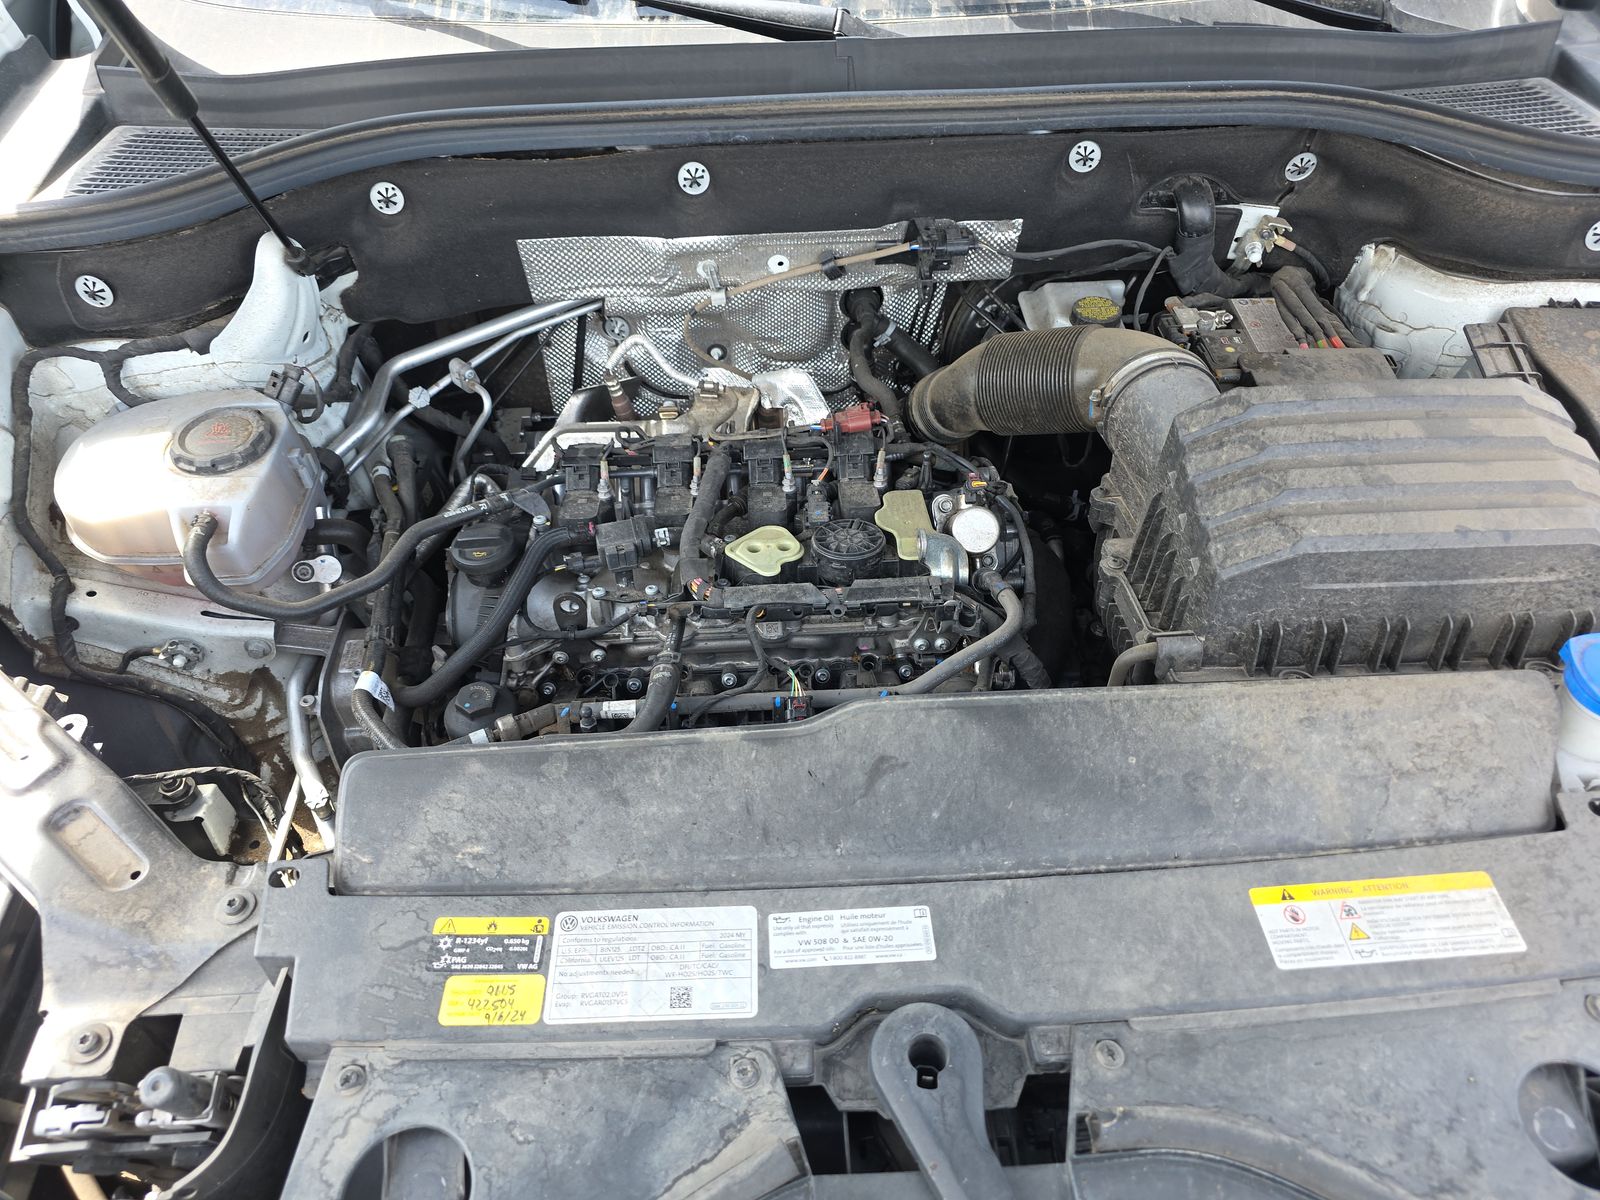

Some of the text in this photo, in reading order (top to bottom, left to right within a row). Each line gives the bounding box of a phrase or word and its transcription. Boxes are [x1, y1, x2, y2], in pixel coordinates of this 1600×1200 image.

[1310, 881, 1410, 897] WARNING ATTENTION
[581, 915, 639, 924] VOLKSWAGEN
[608, 922, 639, 930] EMISSION
[670, 920, 714, 928] INFORMATION
[455, 937, 489, 946] R-1234yf
[521, 938, 530, 947] kg
[451, 956, 467, 965] PAG
[528, 963, 538, 971] AG
